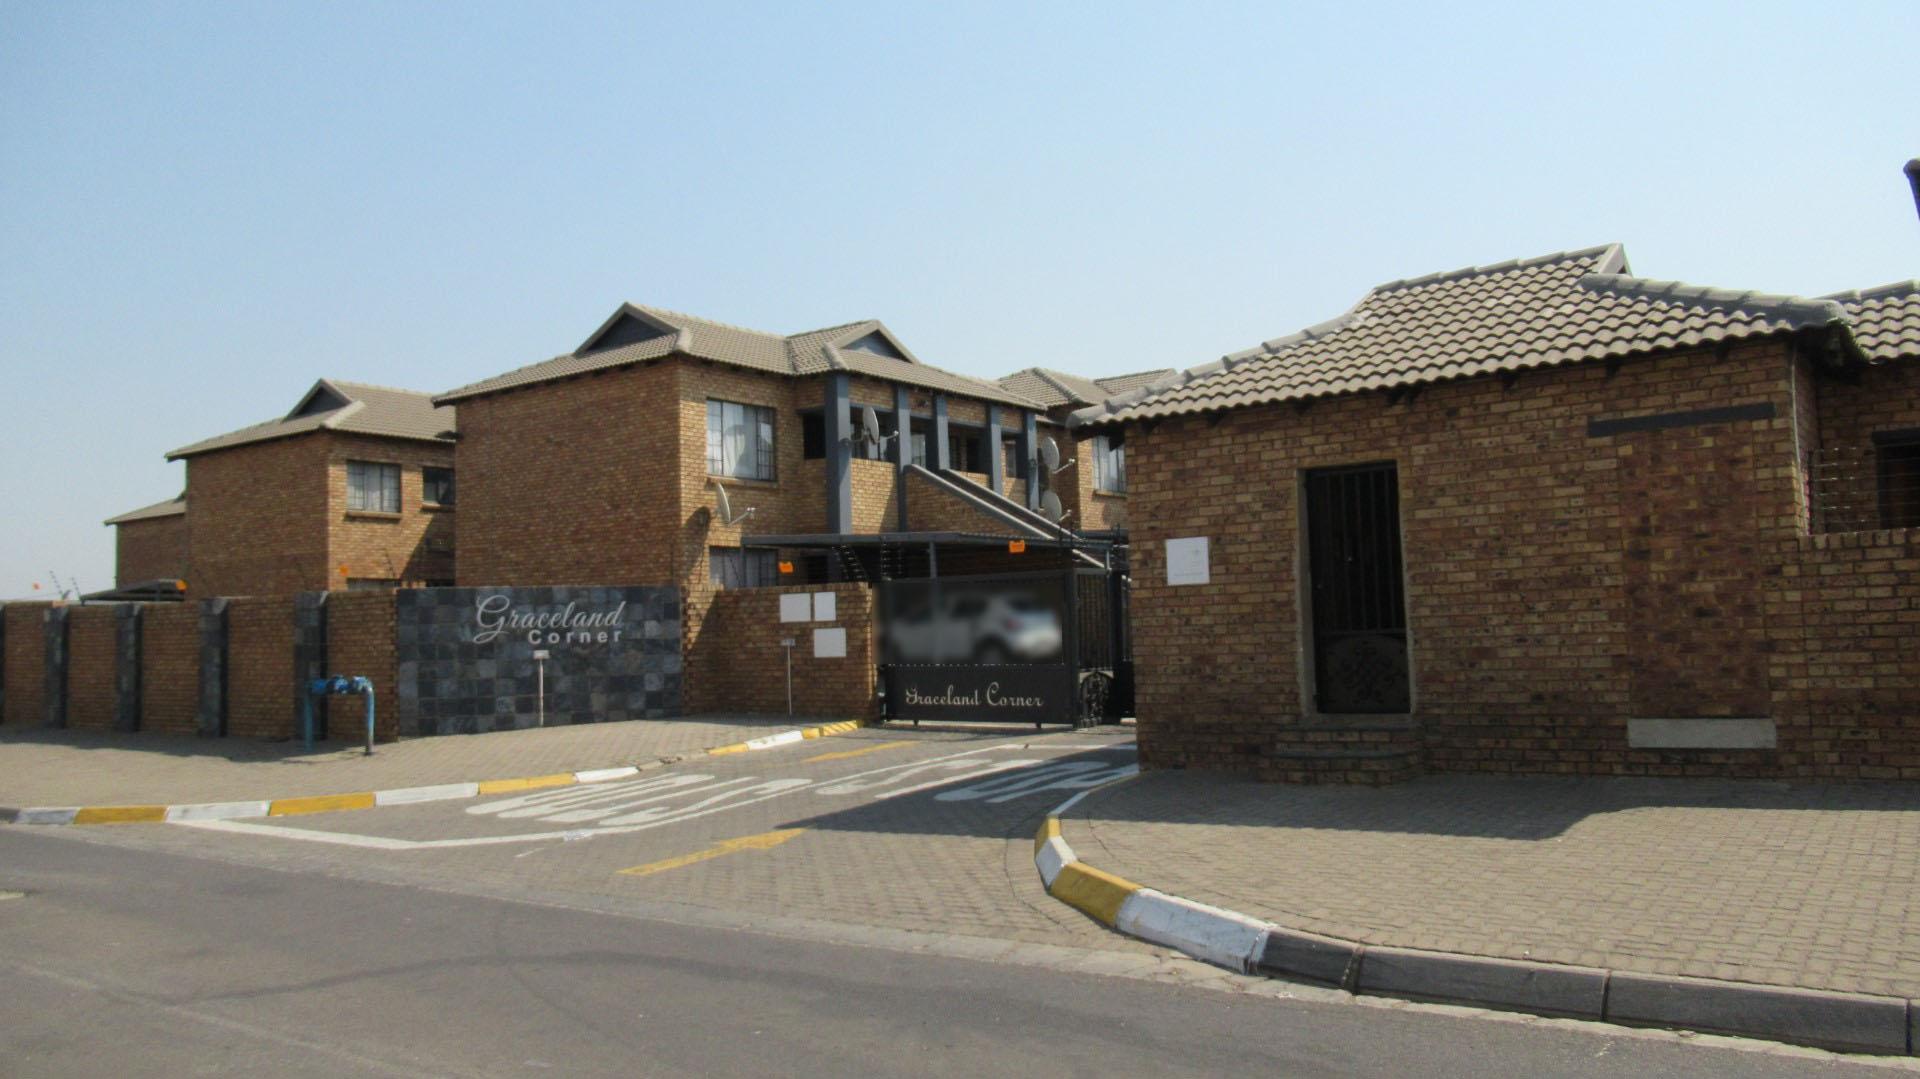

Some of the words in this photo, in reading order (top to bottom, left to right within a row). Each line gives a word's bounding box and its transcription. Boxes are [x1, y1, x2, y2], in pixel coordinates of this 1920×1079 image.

[473, 594, 626, 644] Graceland
[528, 629, 622, 645] Corner
[905, 684, 980, 706] Graceland
[986, 681, 1044, 706] Corner
